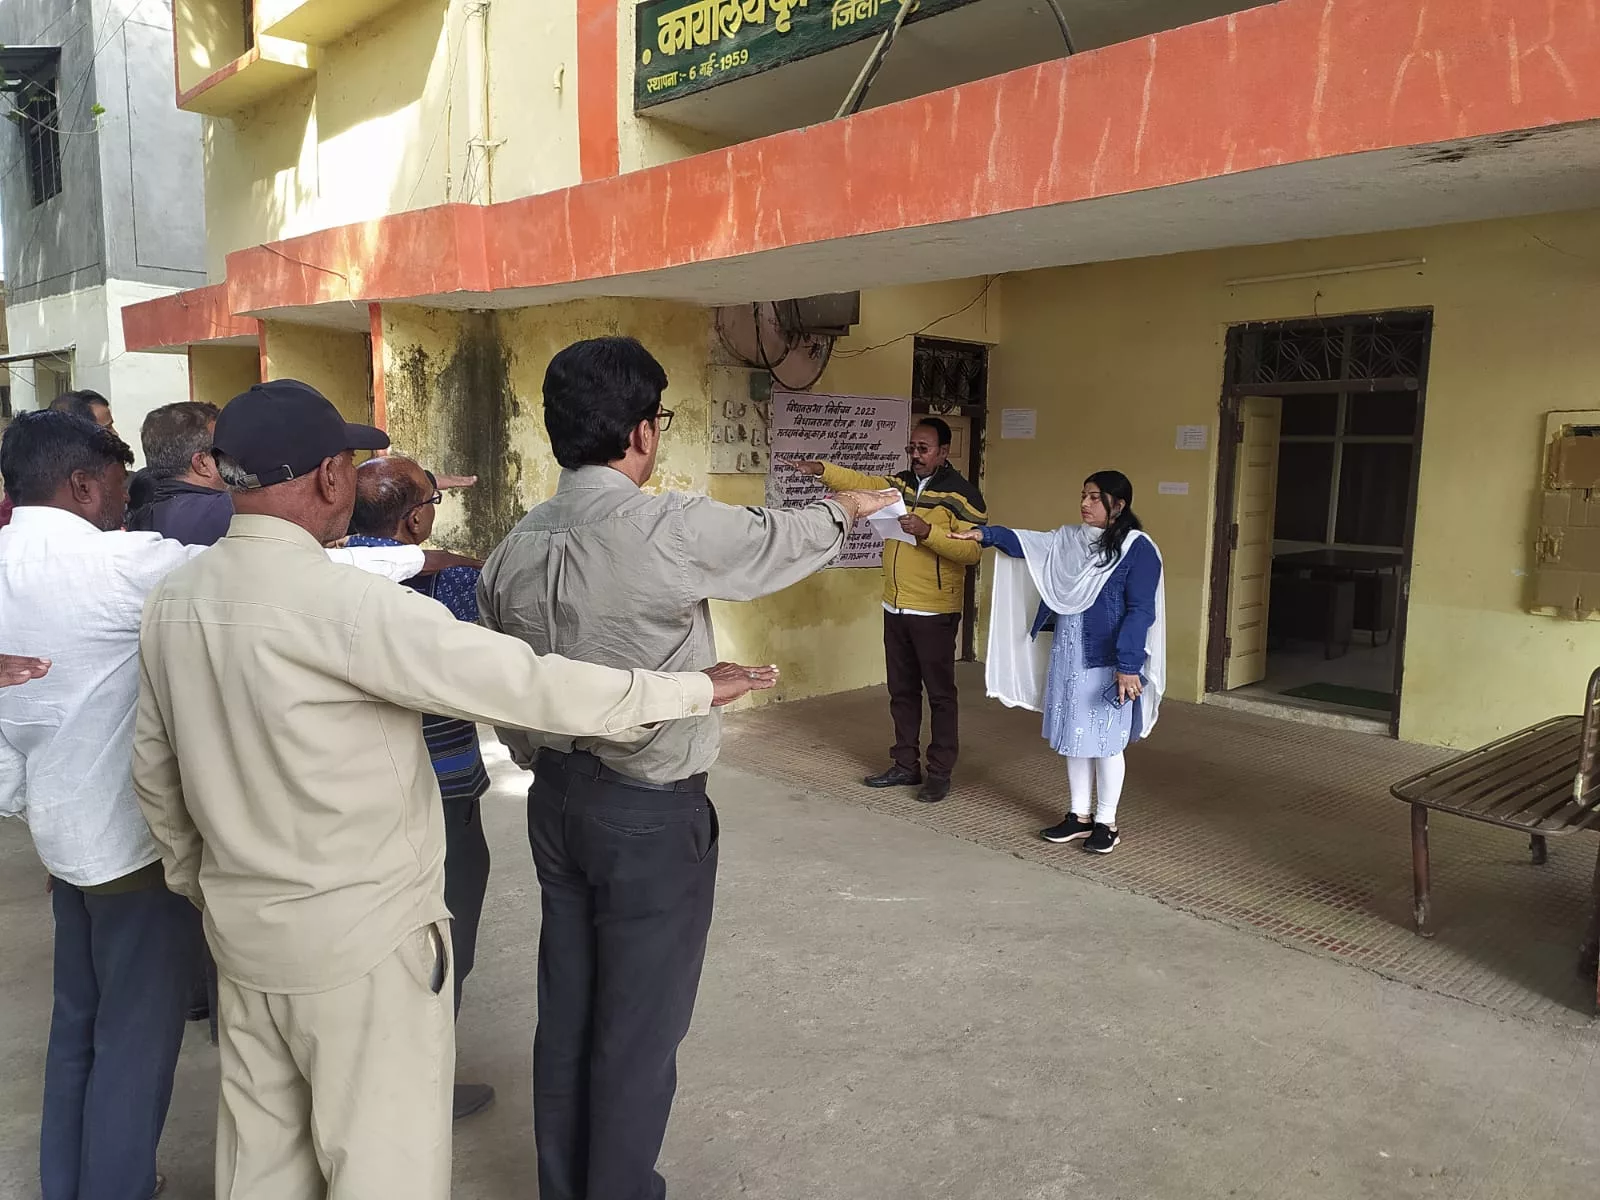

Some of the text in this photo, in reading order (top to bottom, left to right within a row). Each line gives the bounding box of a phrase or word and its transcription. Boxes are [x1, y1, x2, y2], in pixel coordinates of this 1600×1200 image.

[688, 65, 697, 80] 6
[786, 399, 876, 416] विधानसभा निर्वाचन 2023
[793, 413, 831, 426] विधानसभा
